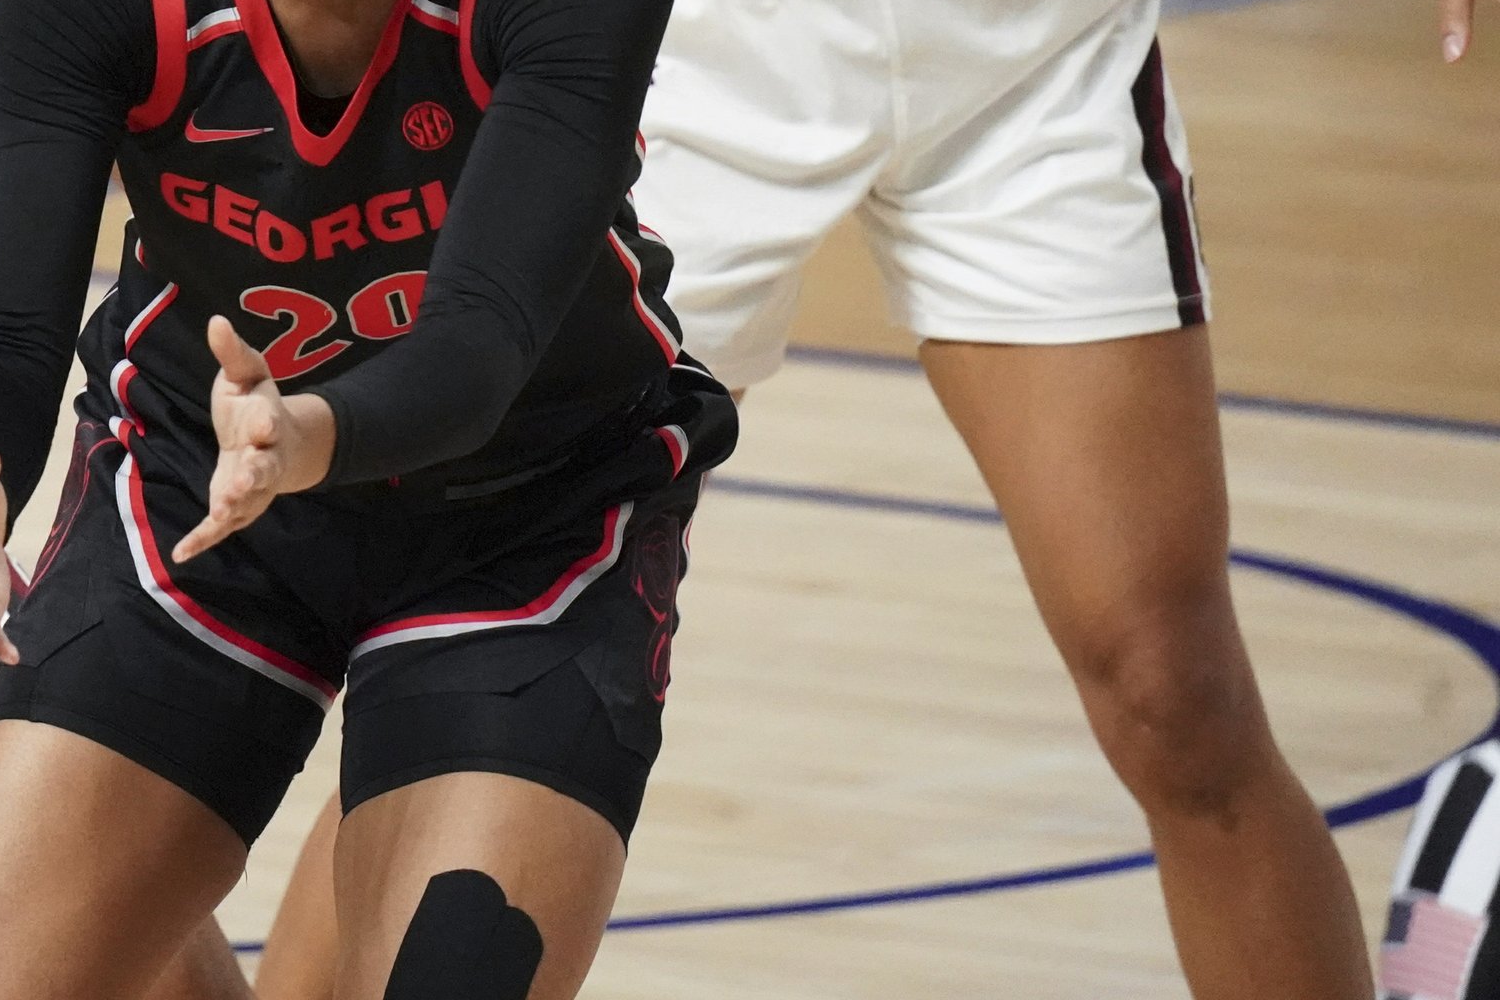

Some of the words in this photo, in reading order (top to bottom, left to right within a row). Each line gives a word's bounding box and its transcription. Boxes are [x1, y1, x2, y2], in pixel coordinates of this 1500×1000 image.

[407, 104, 451, 148] SEC
[160, 172, 449, 263] GEORGI
[239, 270, 429, 381] 20
